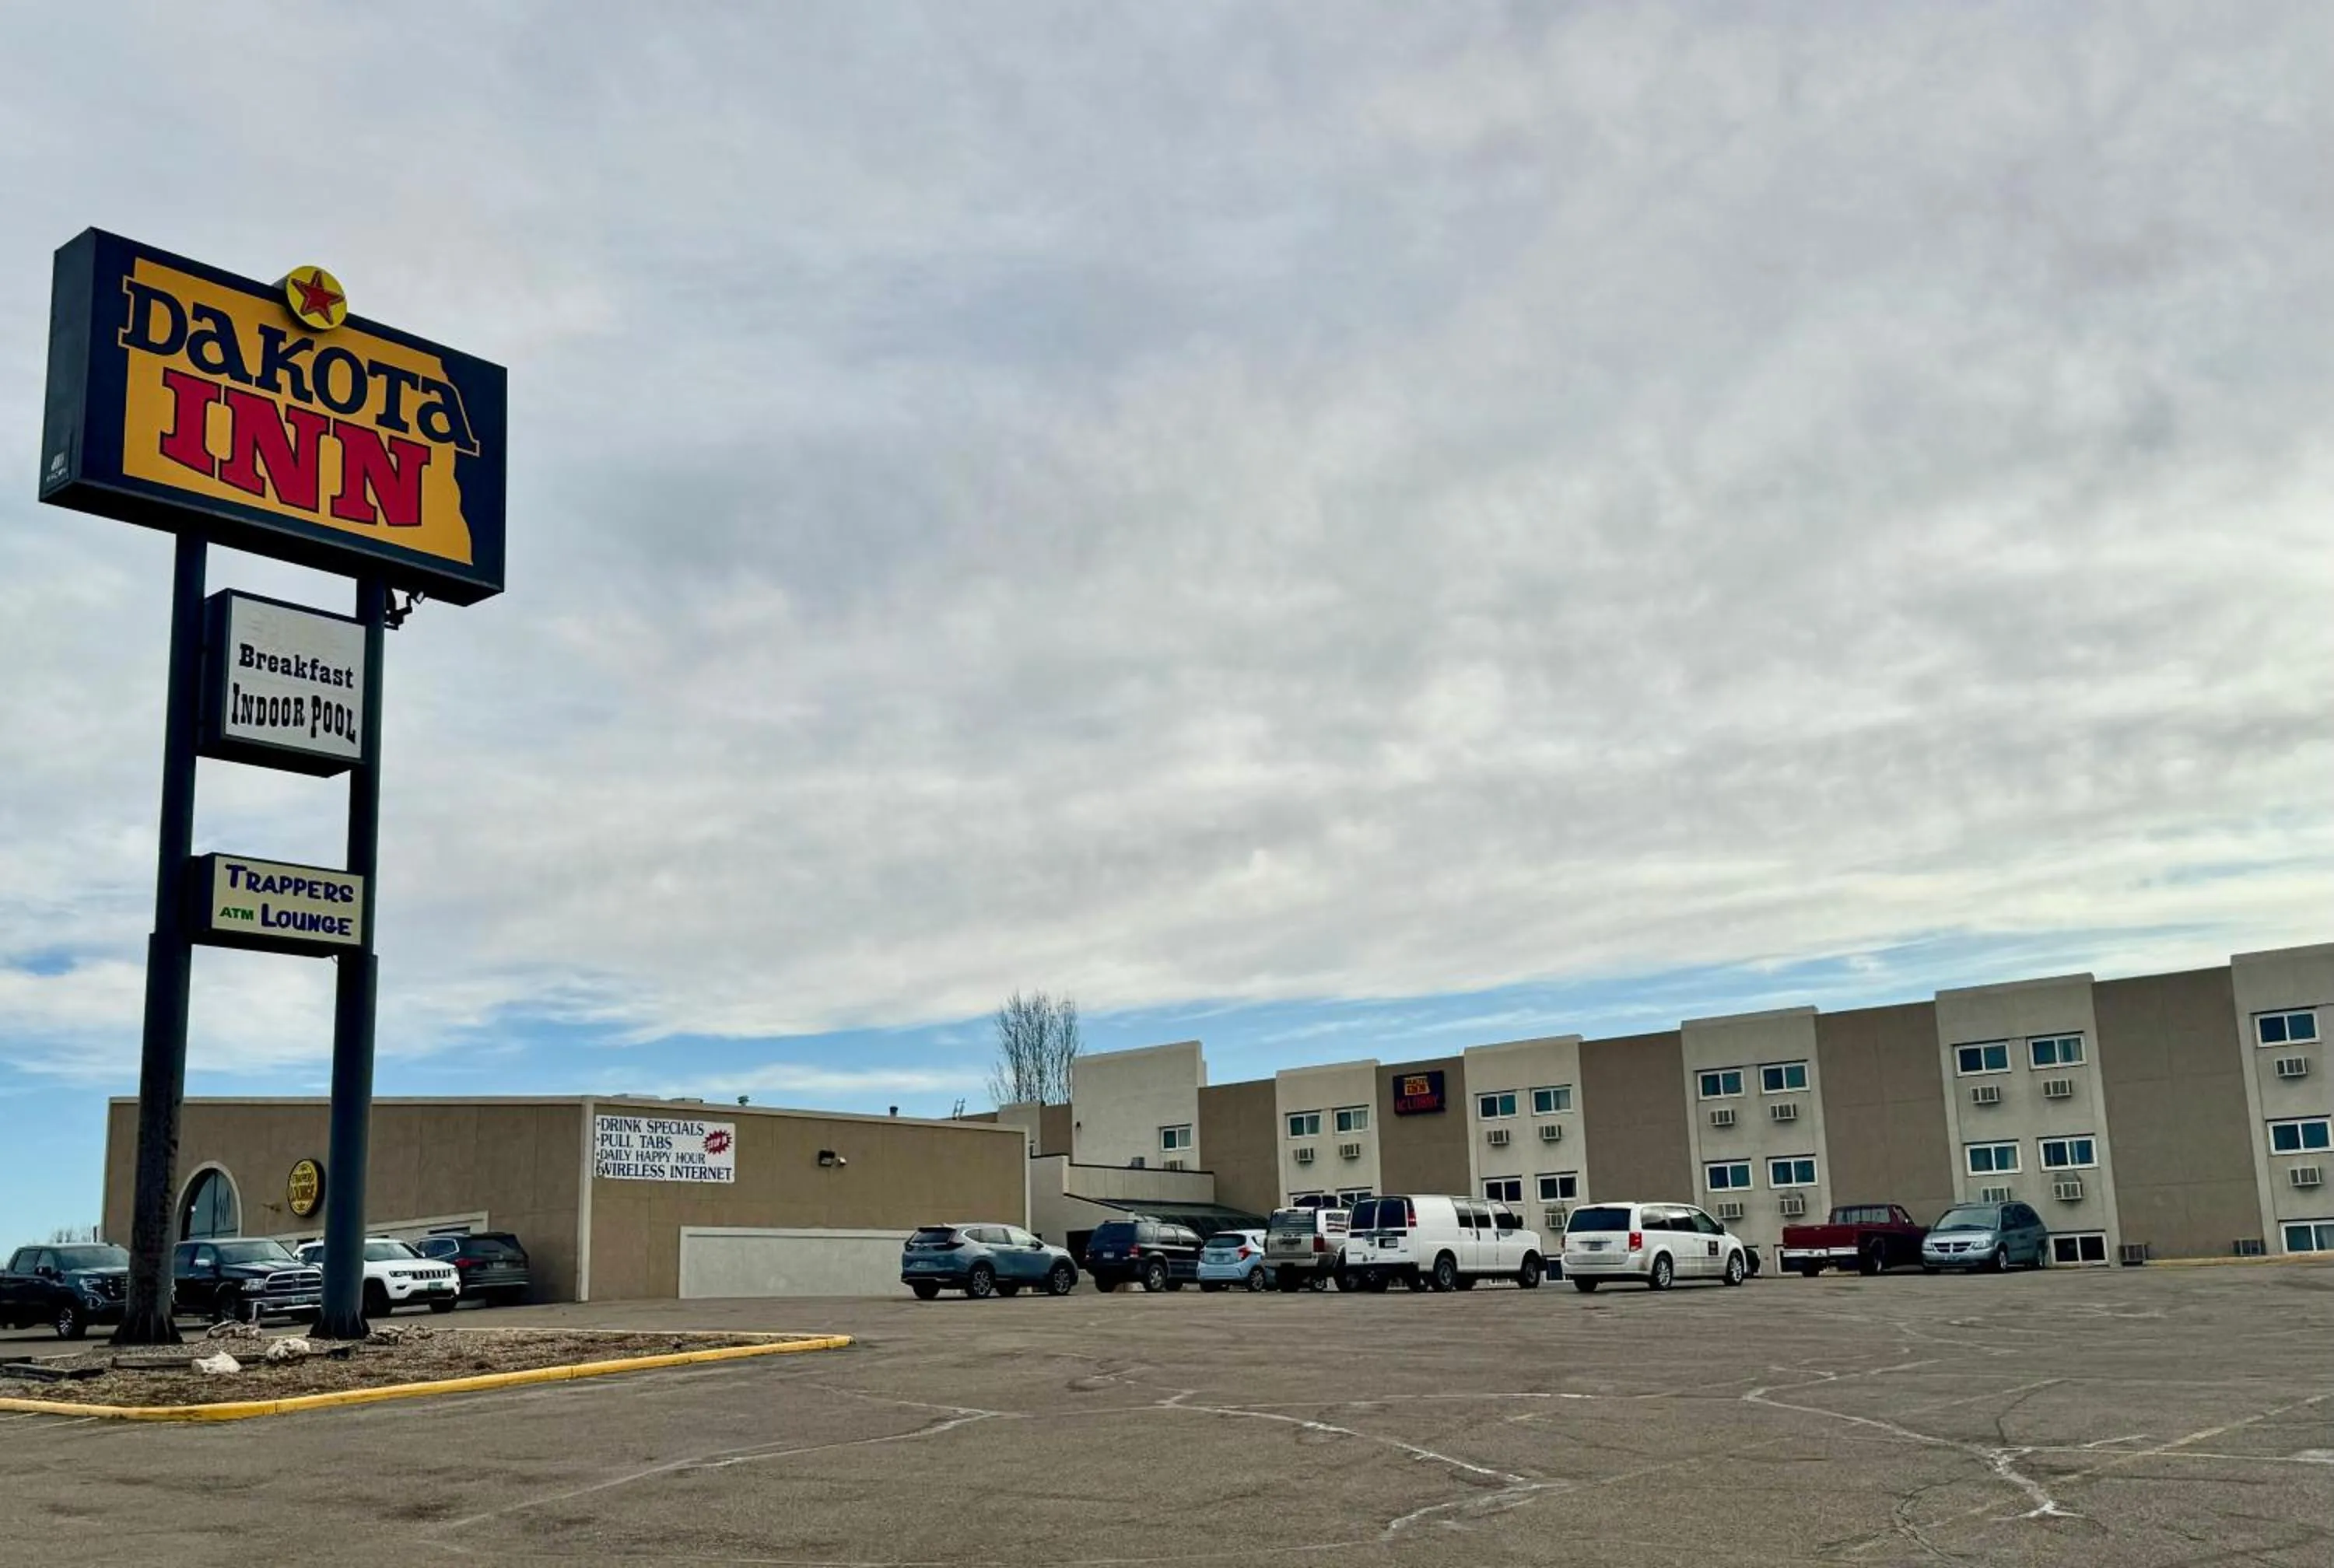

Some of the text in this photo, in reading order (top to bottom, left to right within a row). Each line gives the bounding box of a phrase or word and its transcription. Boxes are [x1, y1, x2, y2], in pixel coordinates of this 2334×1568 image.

[159, 366, 431, 527] INN
[239, 642, 354, 689] Breakfast
[231, 682, 356, 744] INDOOR POOL
[225, 863, 354, 903] TRAPPERS
[219, 903, 353, 936] ATM LOUNGE
[601, 1118, 705, 1136] DRINK SPECIALS
[601, 1133, 673, 1150] PULL TABS
[600, 1150, 706, 1164] DAILY HAPPY HOUR
[601, 1163, 732, 1180] WIRELESS INTERNET
